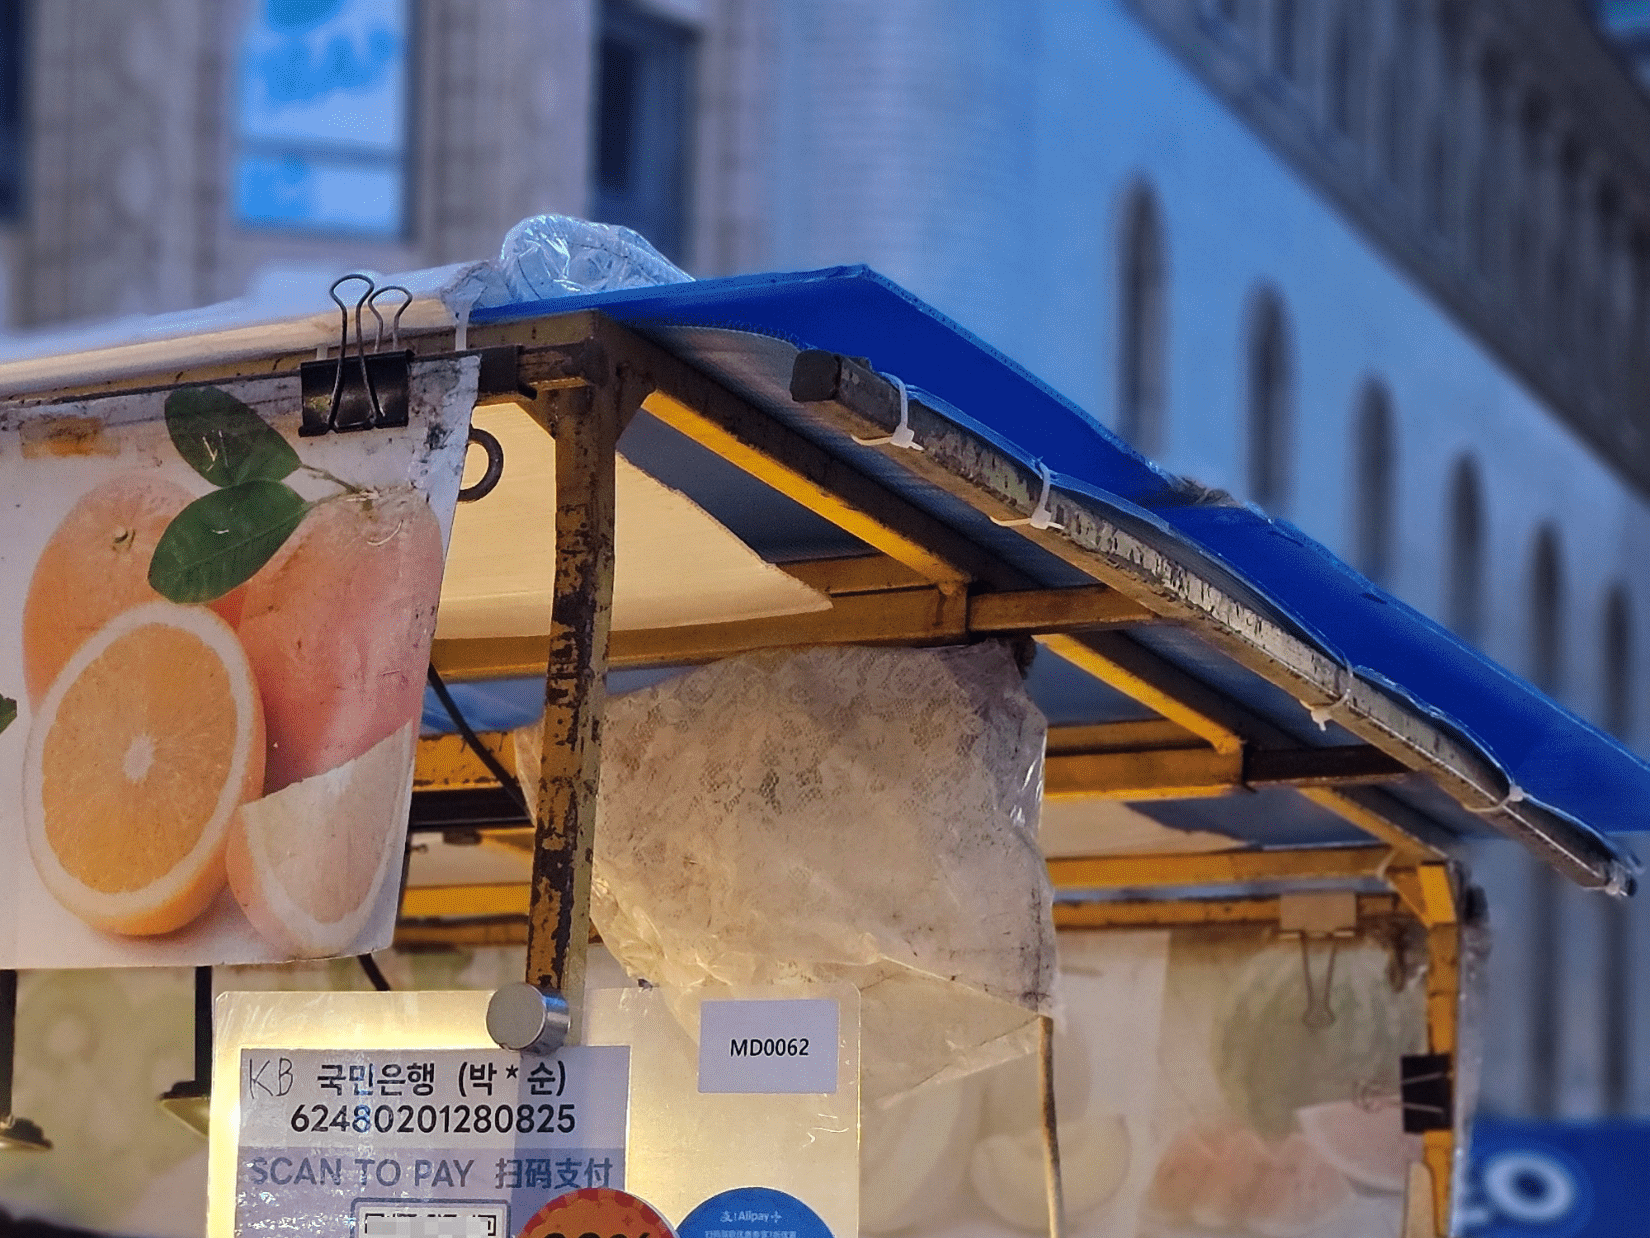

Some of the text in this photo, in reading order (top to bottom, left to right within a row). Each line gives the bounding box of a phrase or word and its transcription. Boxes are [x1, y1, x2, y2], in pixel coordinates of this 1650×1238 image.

[730, 1037, 810, 1058] MD0062
[249, 1057, 295, 1100] KB
[316, 1062, 435, 1096] 국민은행
[290, 1103, 576, 1134] 62480201280825
[250, 1156, 475, 1188] SCAN TO PAY
[494, 1157, 613, 1190] 扫码支付
